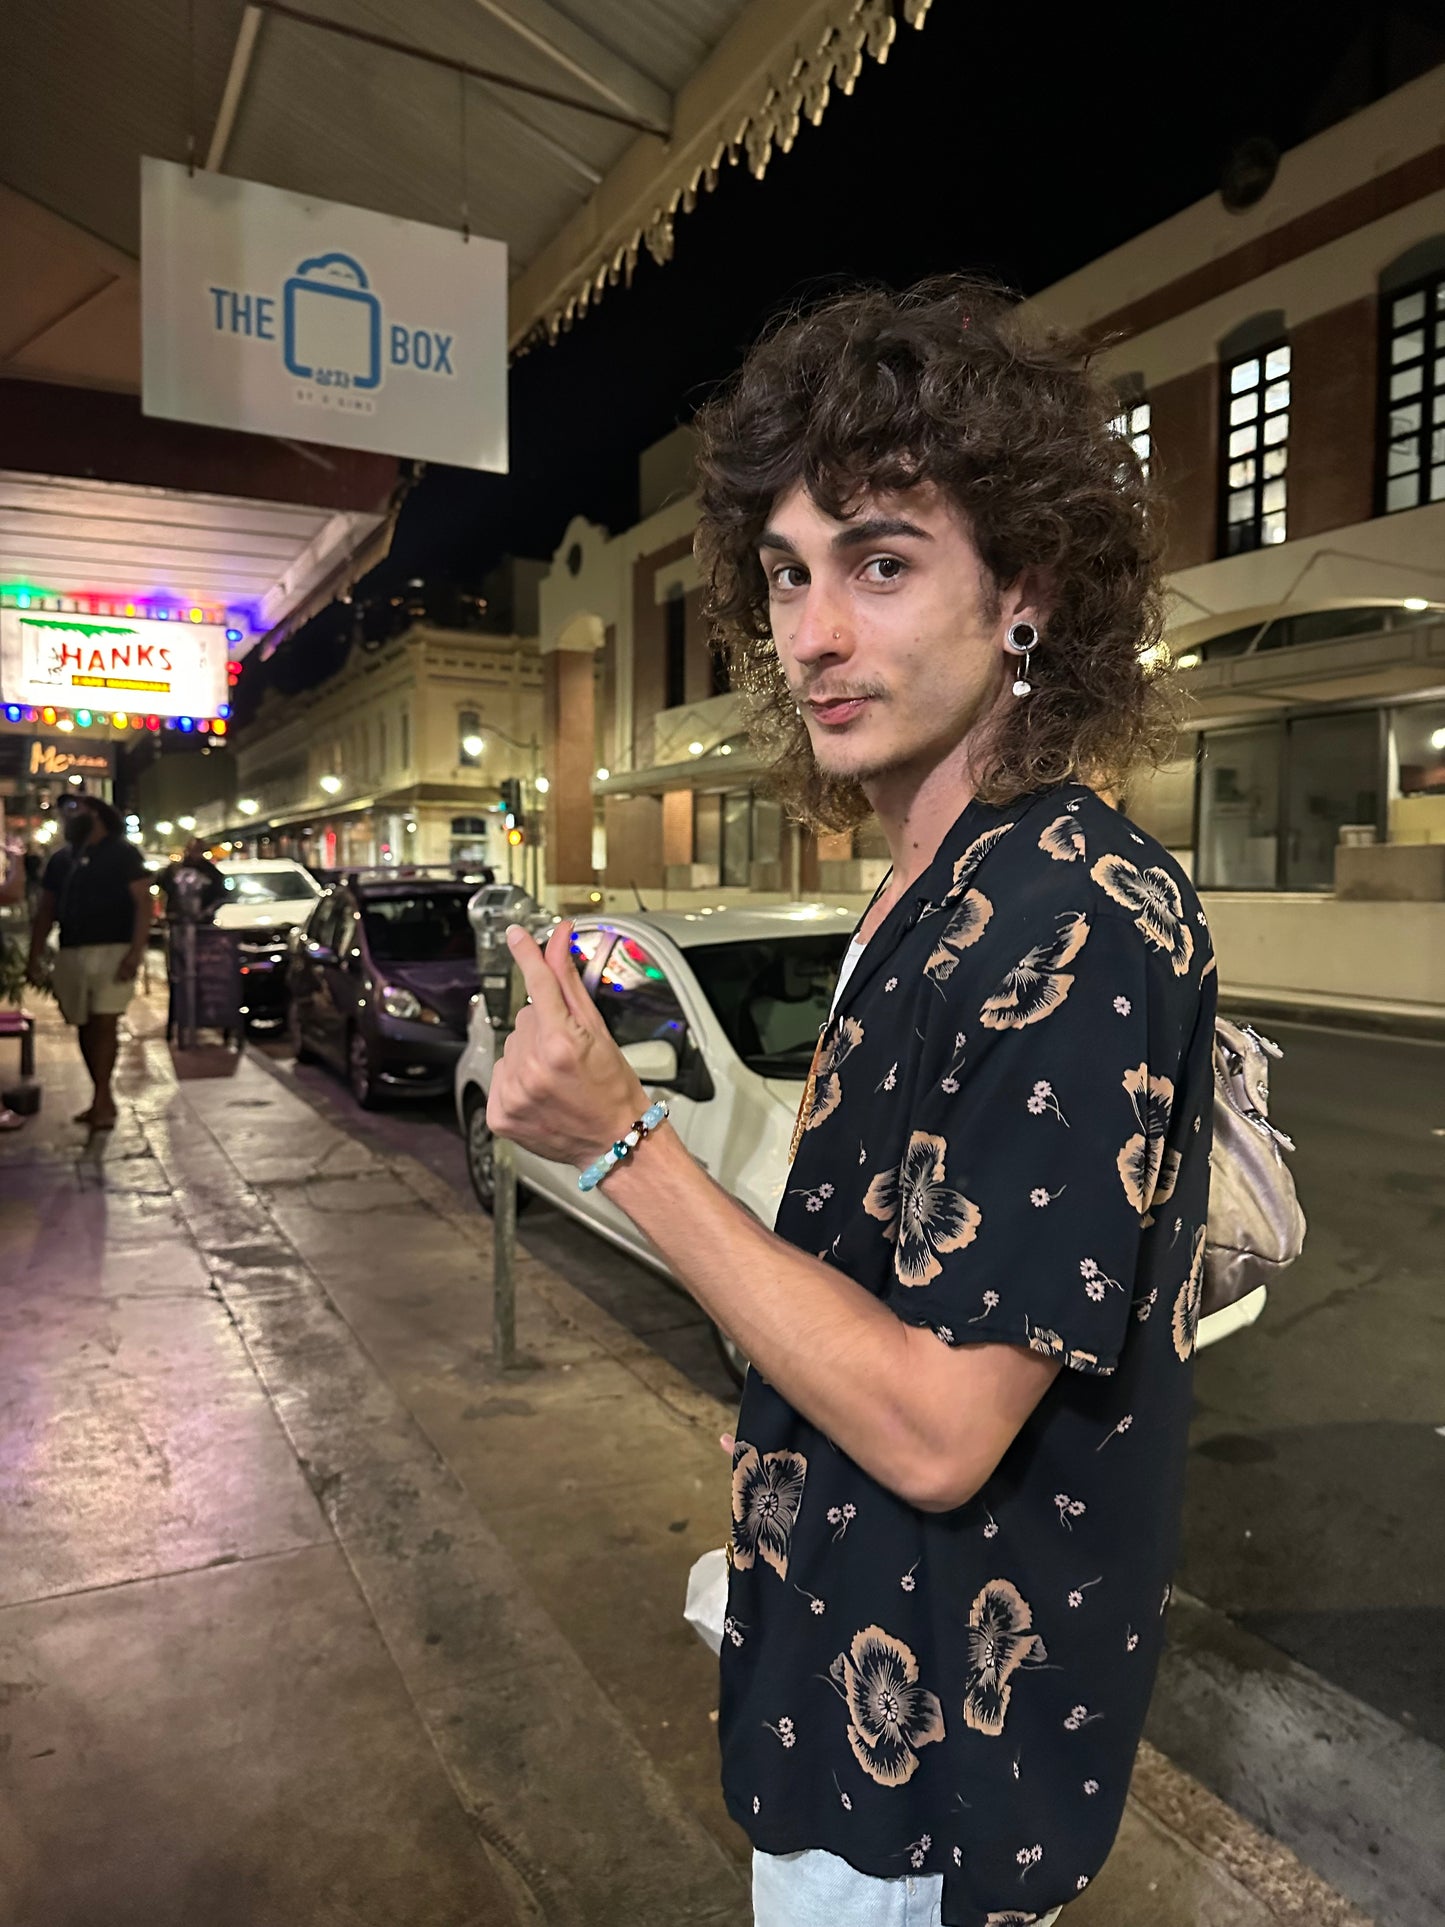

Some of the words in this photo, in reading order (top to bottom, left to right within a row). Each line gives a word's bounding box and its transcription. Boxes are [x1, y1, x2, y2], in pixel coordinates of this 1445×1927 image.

[209, 287, 275, 340] THE
[390, 324, 453, 375] BOX
[61, 642, 172, 671] HANKS
